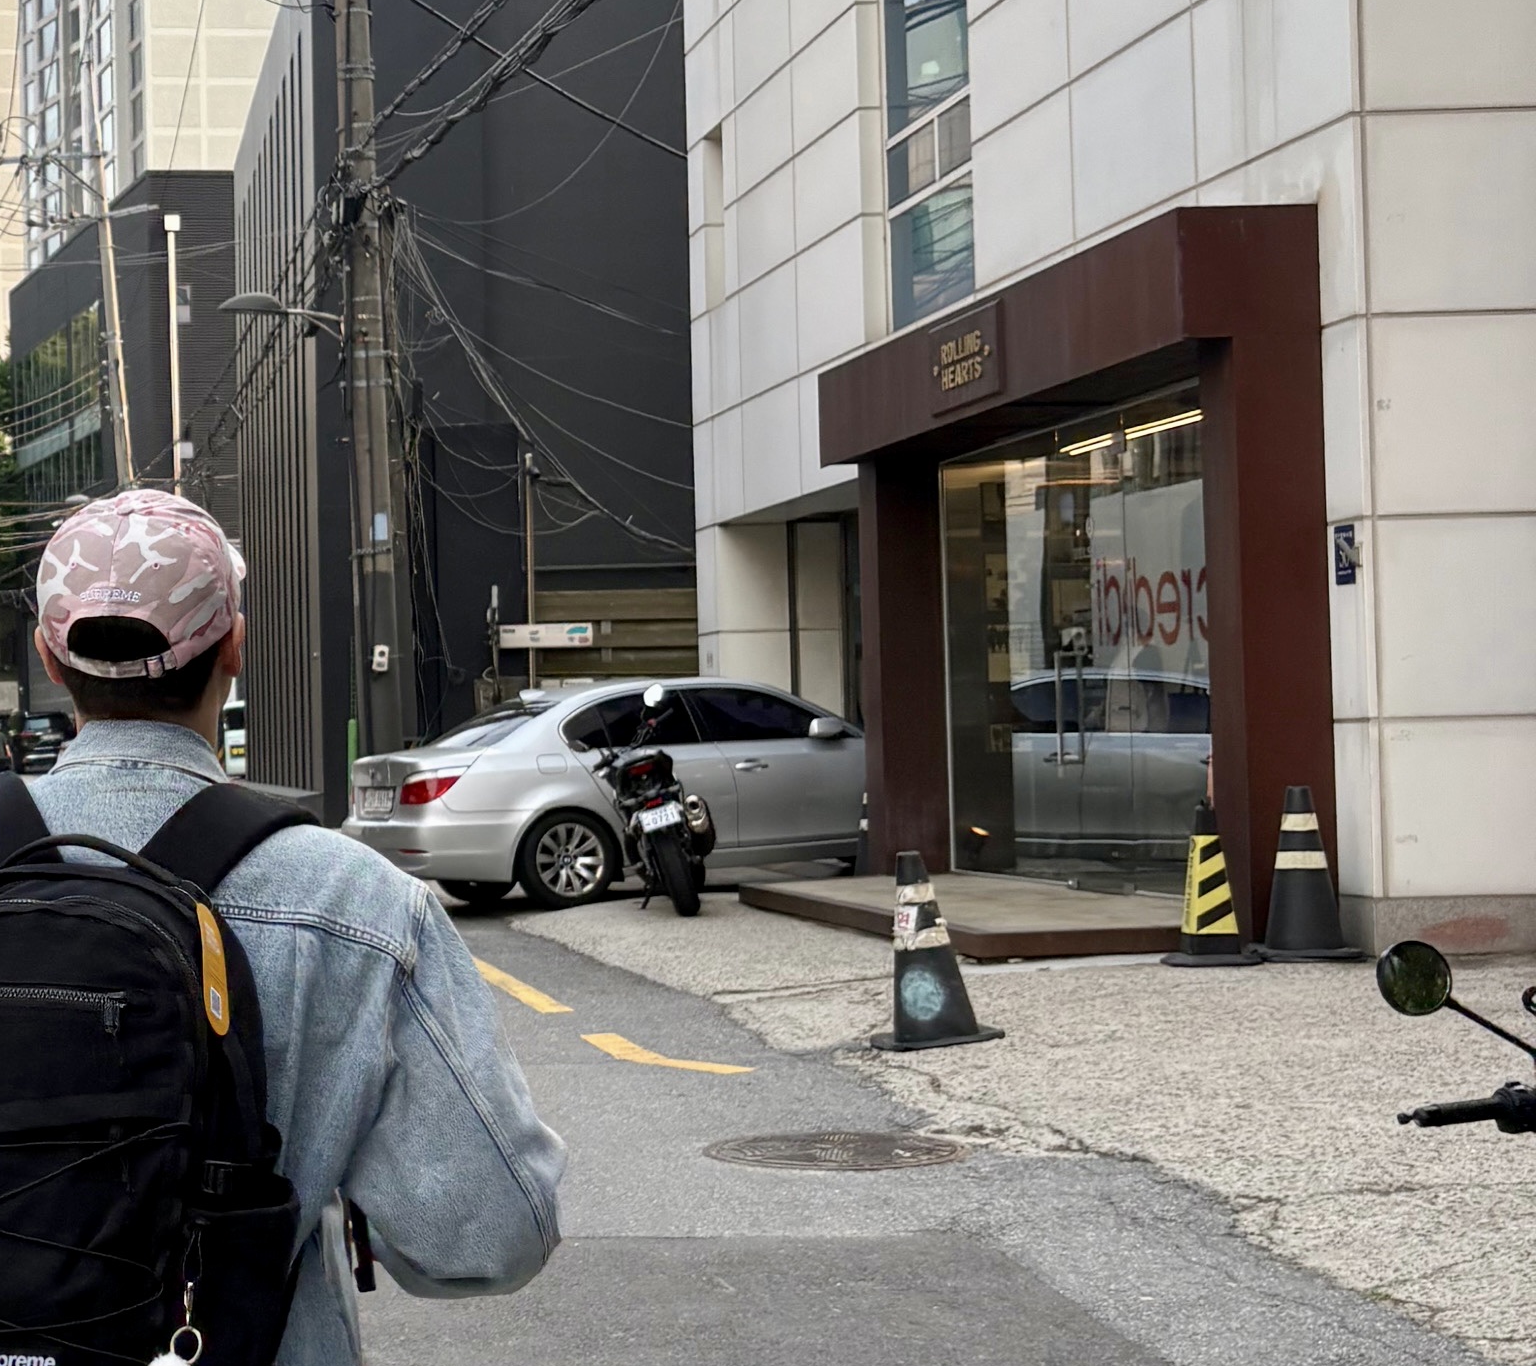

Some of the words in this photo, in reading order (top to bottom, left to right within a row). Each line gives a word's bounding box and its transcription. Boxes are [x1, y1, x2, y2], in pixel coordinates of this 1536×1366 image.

[940, 330, 981, 366] ROLLING
[941, 356, 983, 391] HEARTS
[79, 588, 142, 603] SUPREME
